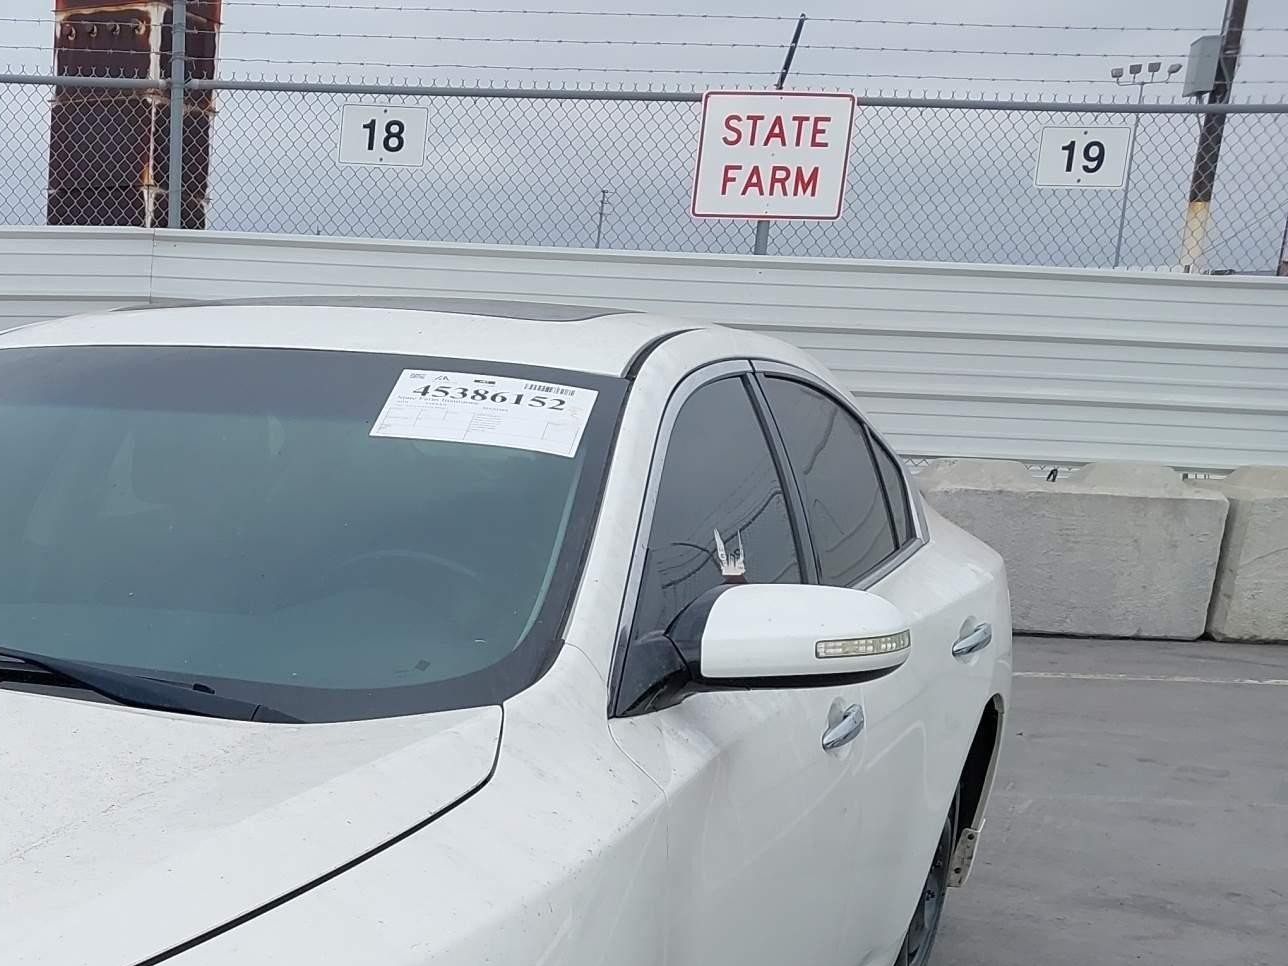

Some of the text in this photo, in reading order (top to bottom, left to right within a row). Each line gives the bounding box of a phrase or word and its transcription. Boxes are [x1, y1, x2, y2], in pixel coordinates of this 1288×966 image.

[362, 118, 405, 153] 18
[721, 114, 832, 148] STATE
[1061, 140, 1106, 174] 19
[720, 164, 821, 198] FARM
[412, 383, 567, 411] 45386152
